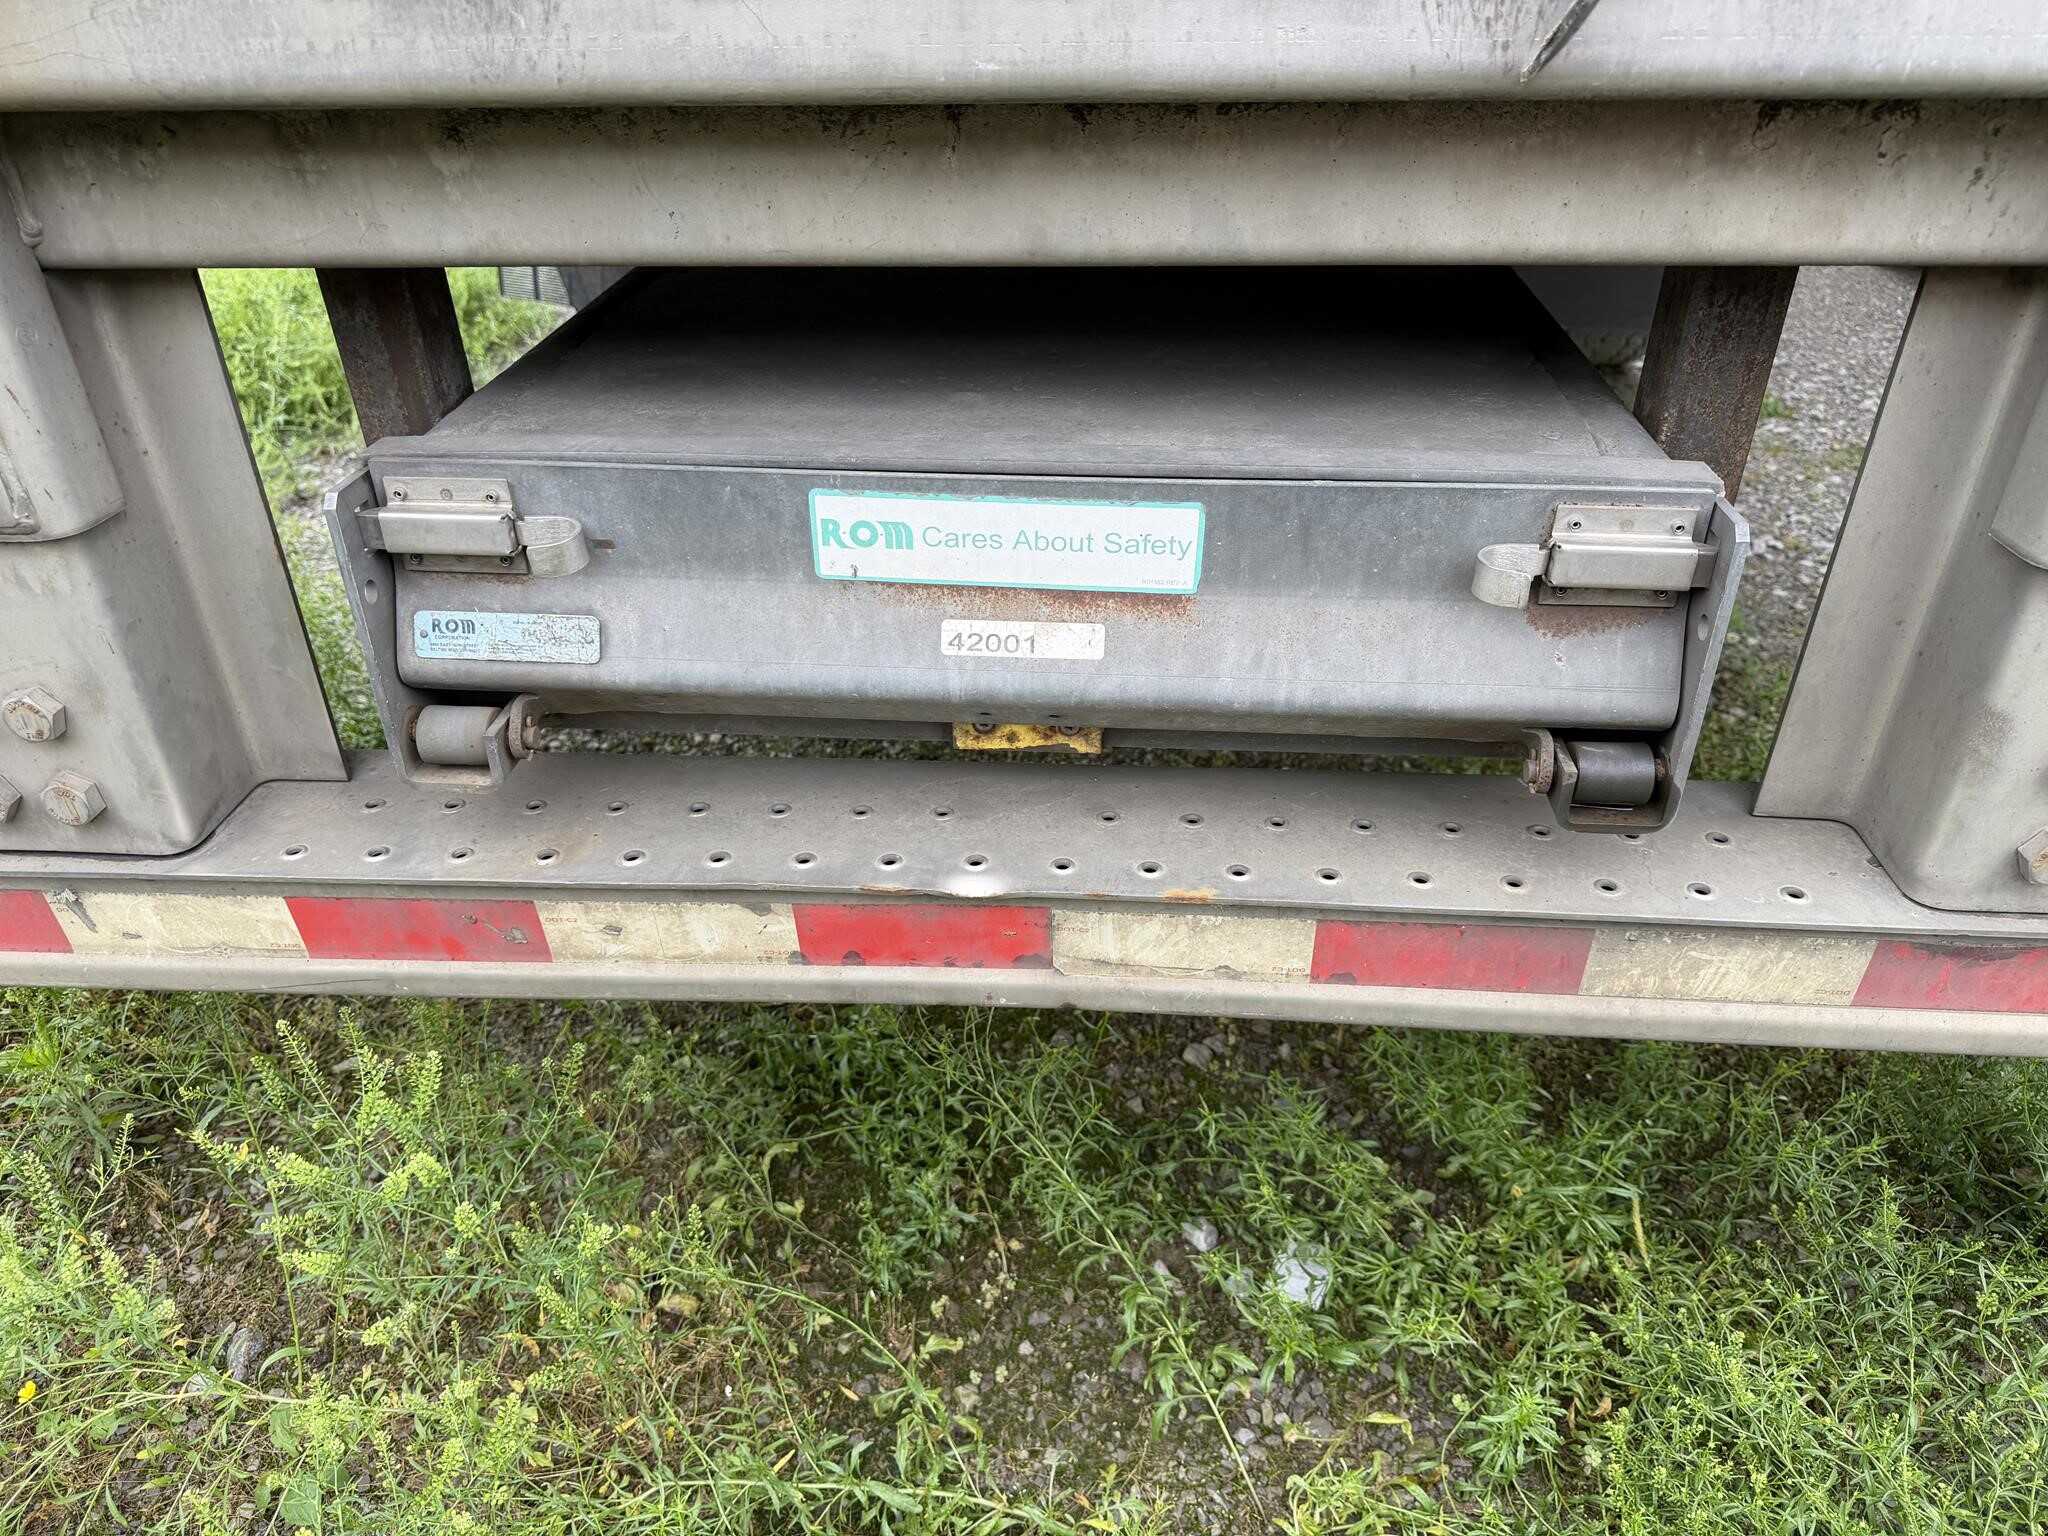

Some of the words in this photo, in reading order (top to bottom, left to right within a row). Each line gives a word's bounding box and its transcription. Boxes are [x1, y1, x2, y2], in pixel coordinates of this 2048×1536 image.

[922, 526, 1003, 550] Cares
[1013, 529, 1095, 554] About
[1103, 531, 1193, 561] Safety
[947, 632, 1036, 655] 42001
